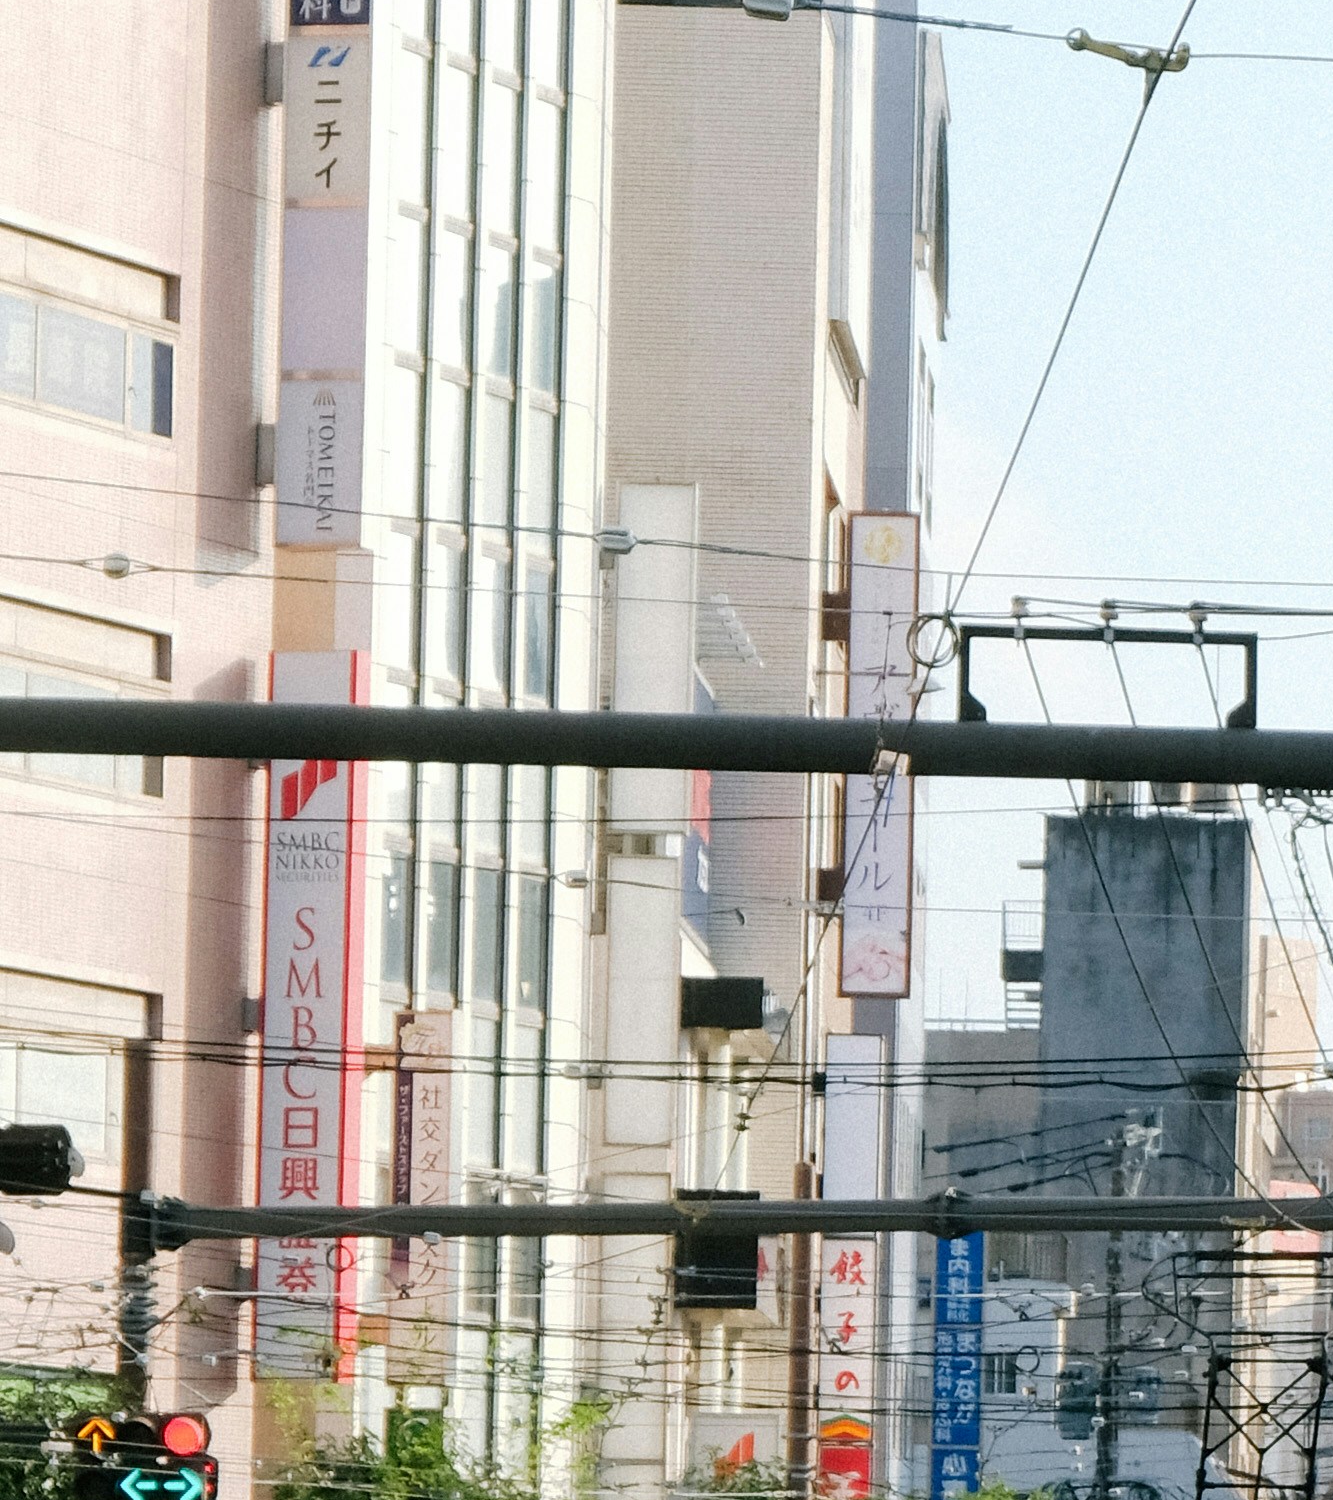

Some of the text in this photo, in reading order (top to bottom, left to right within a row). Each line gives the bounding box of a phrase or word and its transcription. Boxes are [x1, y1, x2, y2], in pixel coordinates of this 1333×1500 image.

[312, 78, 342, 190] ニチイ
[275, 853, 340, 870] NIKKO
[276, 831, 340, 852] SMBC
[275, 905, 321, 1297] SMBC日興券
[829, 1250, 867, 1392] 餃子の
